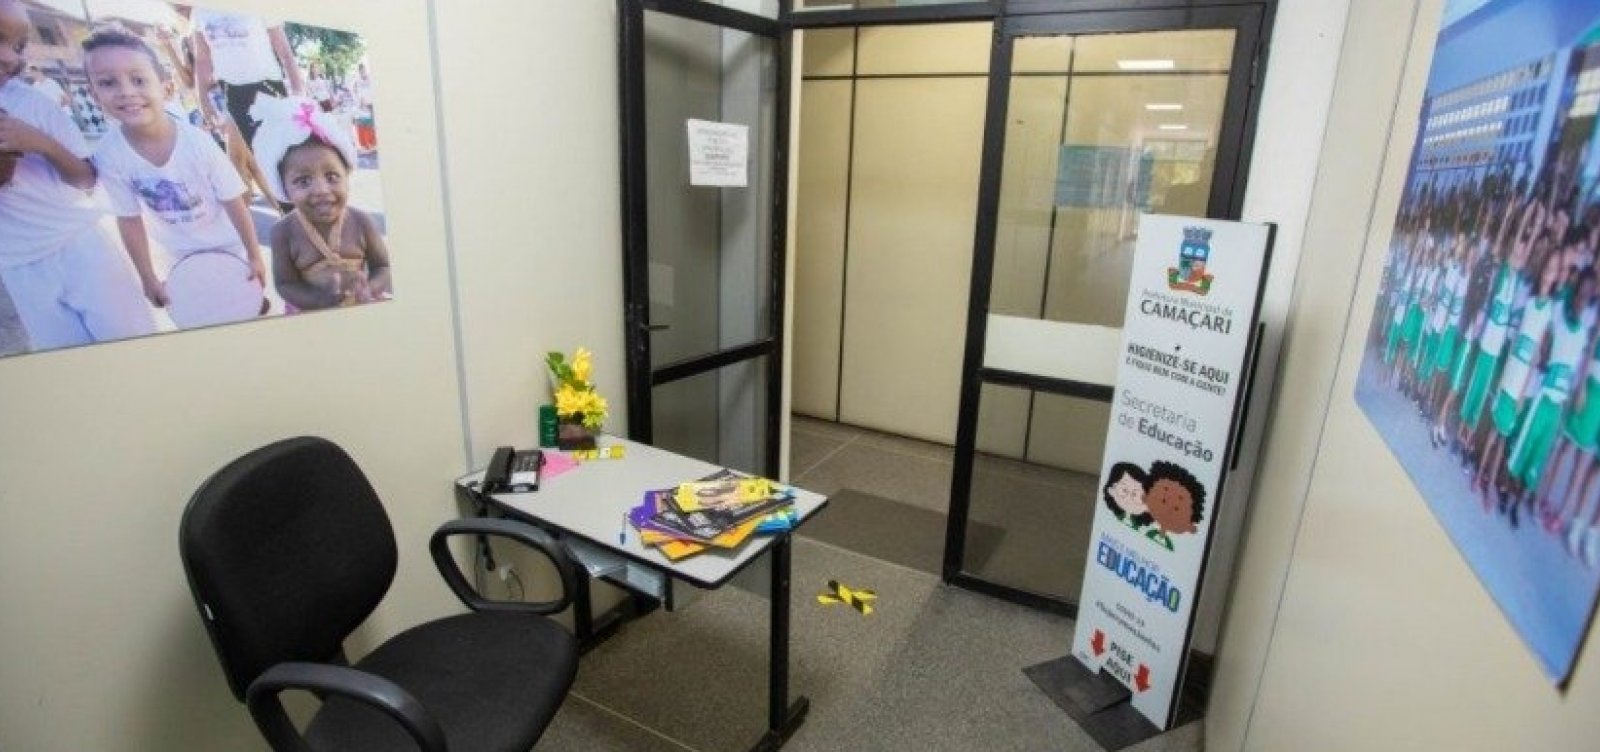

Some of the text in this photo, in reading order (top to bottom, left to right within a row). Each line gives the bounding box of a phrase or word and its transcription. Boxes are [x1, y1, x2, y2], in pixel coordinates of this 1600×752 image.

[1140, 299, 1232, 334] CAMAÇARI
[1127, 343, 1230, 384] HIGIENIZE-SE AQUI
[1121, 388, 1197, 433] Secretaria
[1118, 411, 1213, 463] de Educação
[1097, 541, 1181, 613] EDUCAÇÃO
